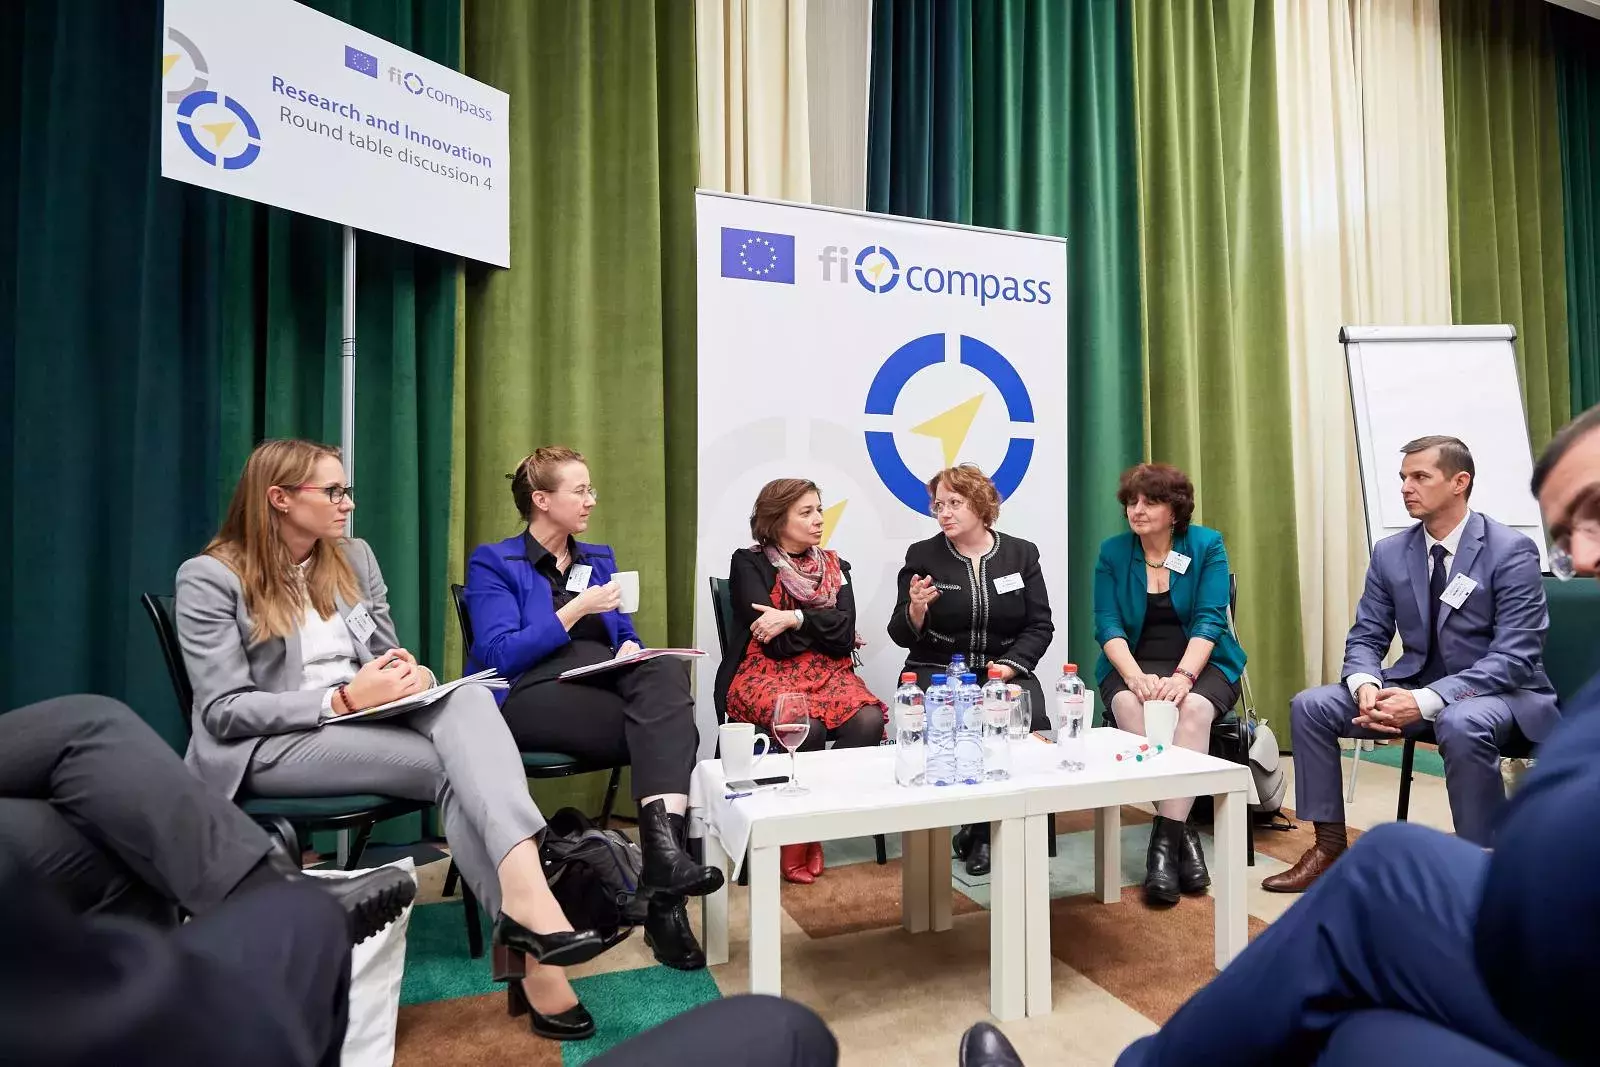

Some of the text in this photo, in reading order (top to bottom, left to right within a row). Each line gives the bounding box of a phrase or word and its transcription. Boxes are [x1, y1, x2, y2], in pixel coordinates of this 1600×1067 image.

[272, 75, 493, 168] Research and Innovation
[426, 86, 493, 122] compass
[280, 105, 493, 191] Round table discussion 4
[905, 266, 1052, 307] compass
